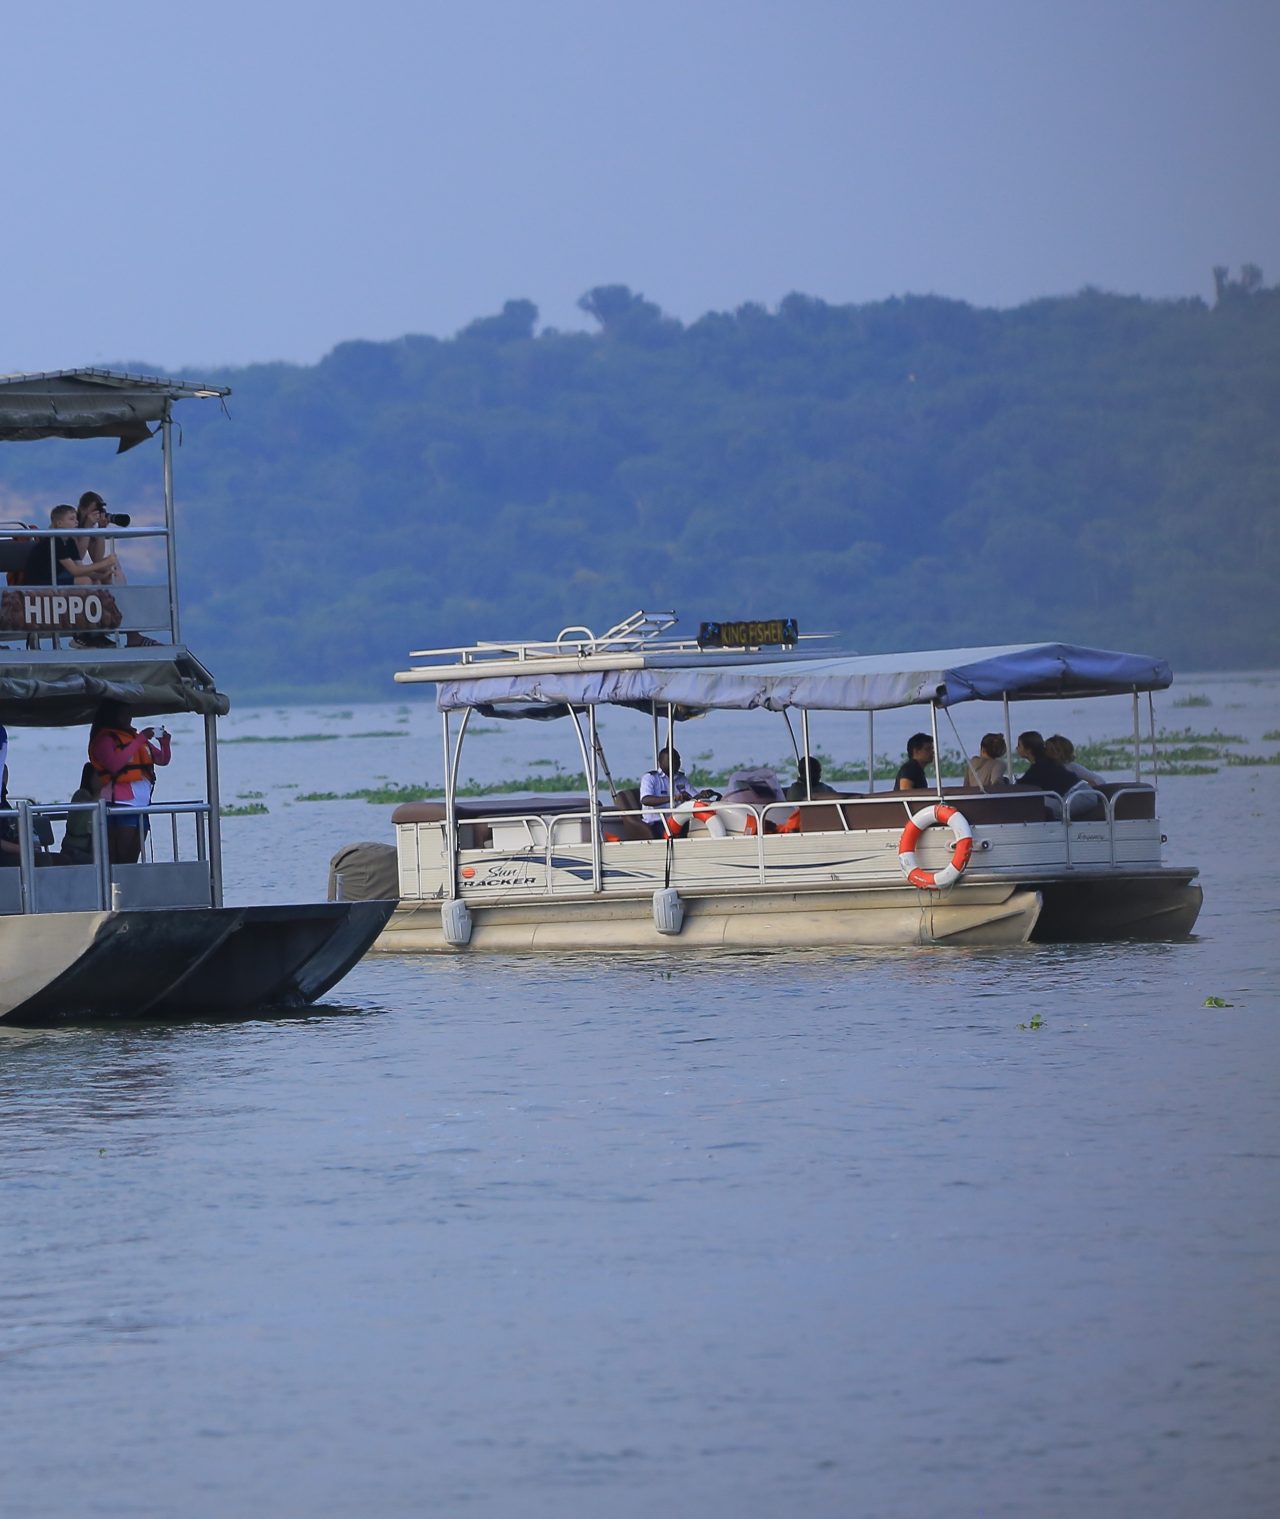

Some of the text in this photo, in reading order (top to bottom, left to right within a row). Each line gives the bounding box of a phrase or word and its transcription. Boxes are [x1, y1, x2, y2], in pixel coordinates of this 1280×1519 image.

[24, 594, 103, 625] HIPPO
[721, 621, 784, 644] KING FISHER
[486, 865, 518, 878] Sun
